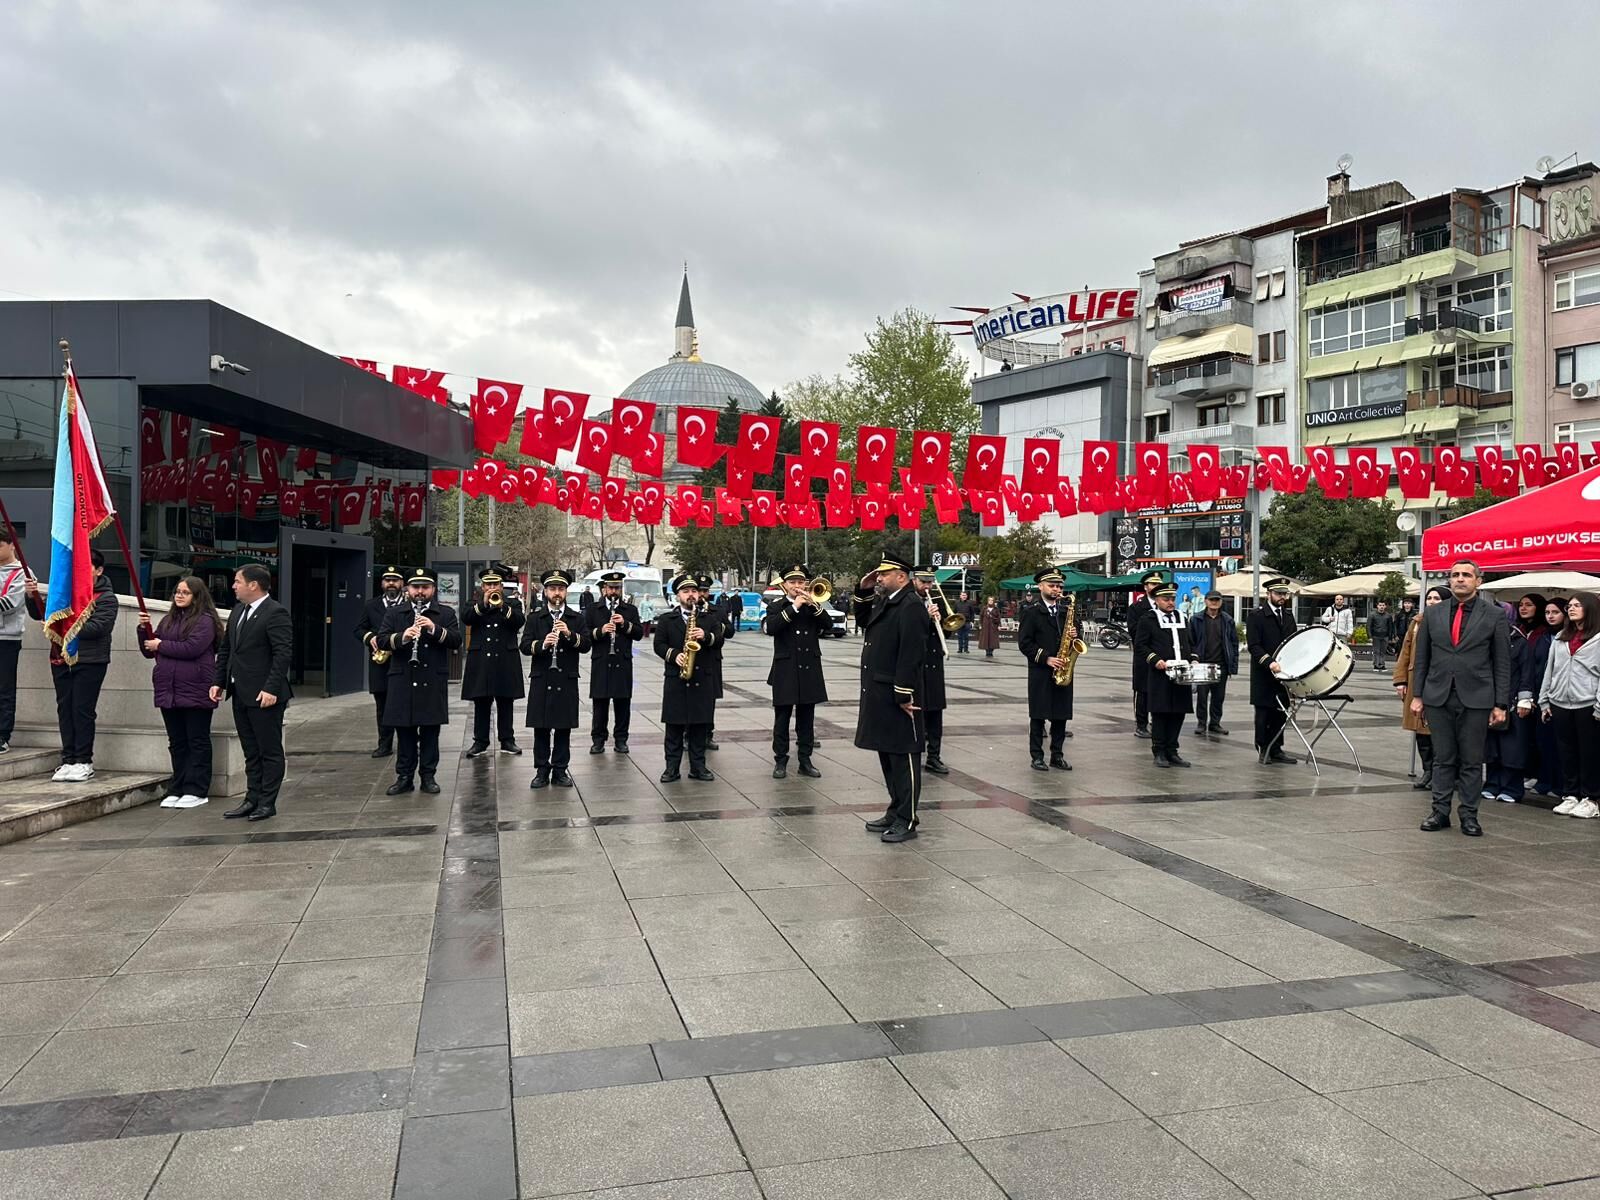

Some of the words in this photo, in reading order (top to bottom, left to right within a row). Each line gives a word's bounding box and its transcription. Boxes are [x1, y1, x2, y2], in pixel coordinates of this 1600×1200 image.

[1306, 411, 1337, 426] UNIQ
[1338, 411, 1353, 421] Art
[1354, 405, 1401, 419] Collective
[77, 472, 88, 529] ORTAOKULU
[1216, 503, 1242, 511] STUDIO
[1143, 519, 1151, 556] TATTOO
